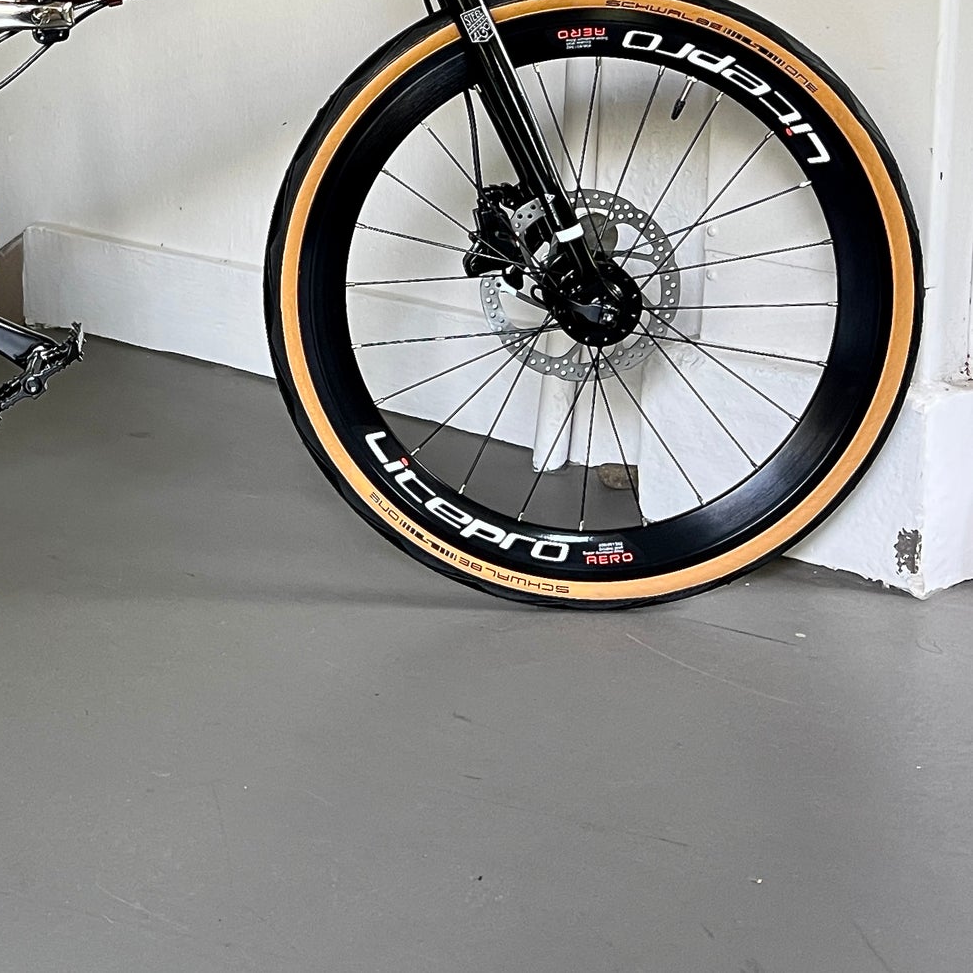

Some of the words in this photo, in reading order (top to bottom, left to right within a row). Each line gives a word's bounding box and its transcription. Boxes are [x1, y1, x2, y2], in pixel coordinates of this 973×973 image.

[605, 0, 724, 30] SCHWALBE
[557, 27, 606, 40] AERO
[586, 552, 634, 565] AERO
[458, 555, 570, 594] SCHWALBE
